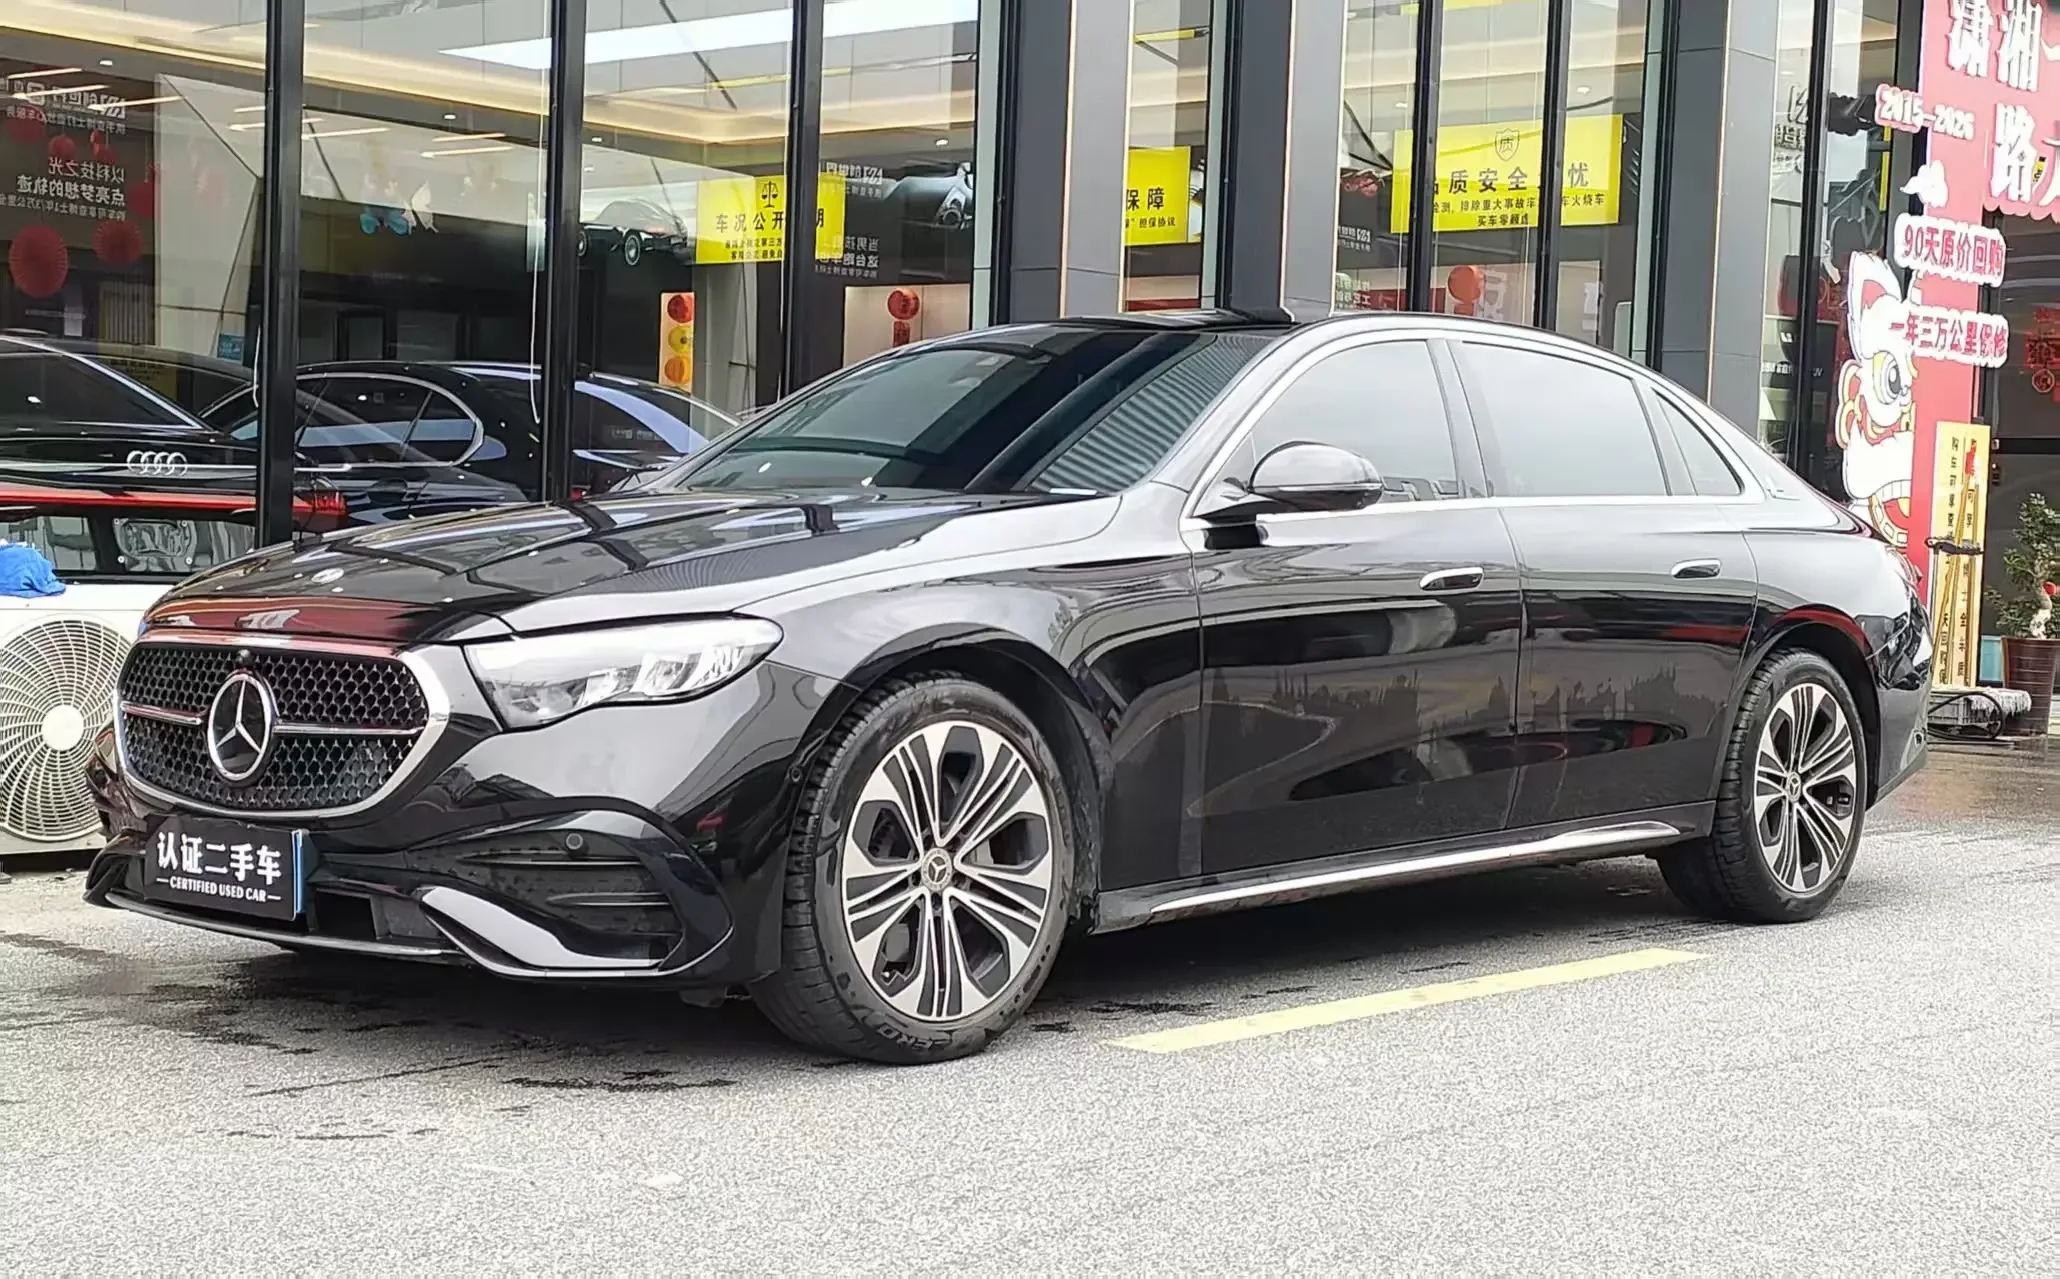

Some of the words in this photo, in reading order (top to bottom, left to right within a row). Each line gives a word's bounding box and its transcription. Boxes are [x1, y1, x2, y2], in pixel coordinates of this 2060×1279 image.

[1125, 187, 1165, 211] 保障
[716, 208, 824, 233] 车况公开
[1889, 312, 2008, 358] 一年三万公里保修
[157, 831, 282, 885] 认证二手车
[169, 875, 218, 896] CERTIFIED
[219, 882, 243, 898] USED
[245, 886, 267, 903] CAR
